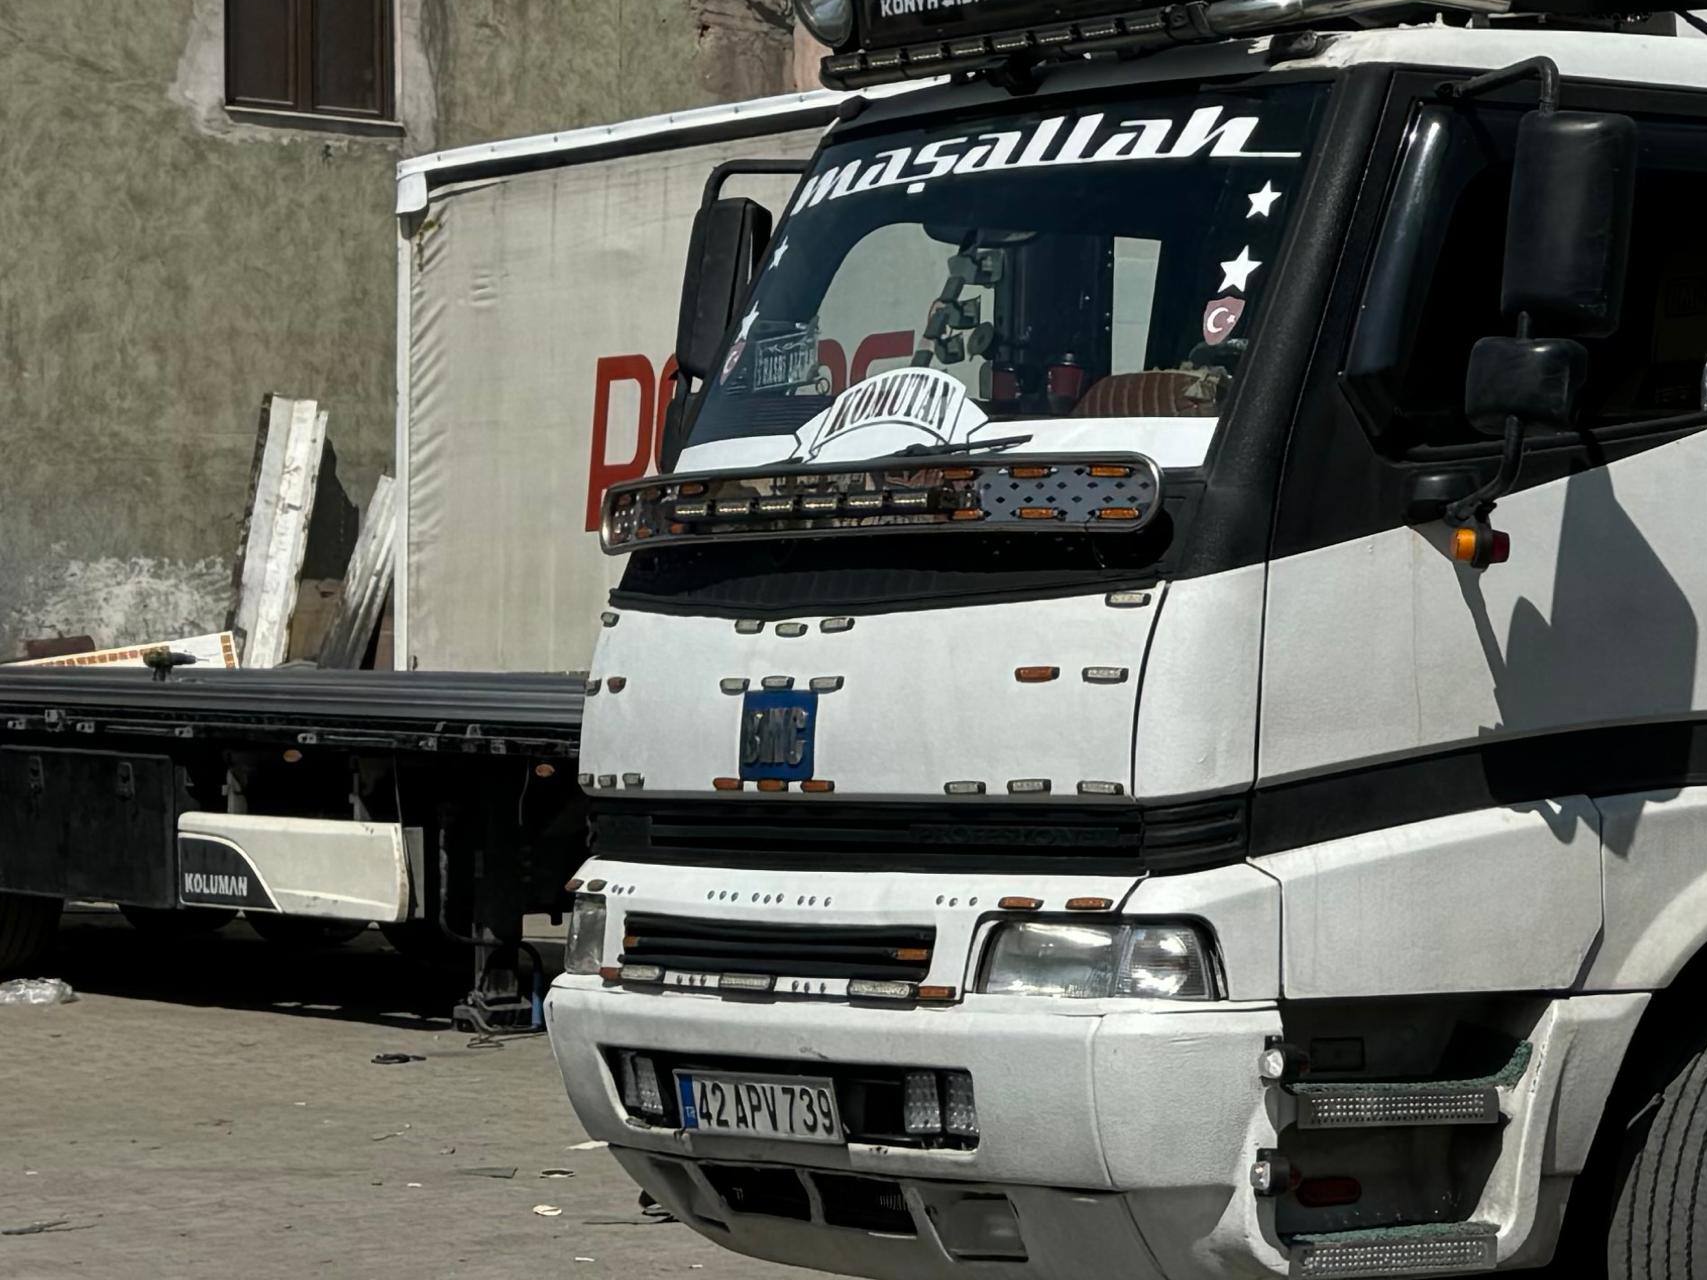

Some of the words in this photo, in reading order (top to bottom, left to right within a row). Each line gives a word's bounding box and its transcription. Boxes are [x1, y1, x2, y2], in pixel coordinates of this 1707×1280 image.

[790, 105, 1302, 216] maşallah
[826, 374, 956, 438] KOMUTAN
[743, 707, 809, 766] BMC
[185, 873, 248, 897] KOLUMAN
[700, 1082, 729, 1128] 42
[734, 1083, 779, 1132] APV
[782, 1086, 834, 1136] 739
